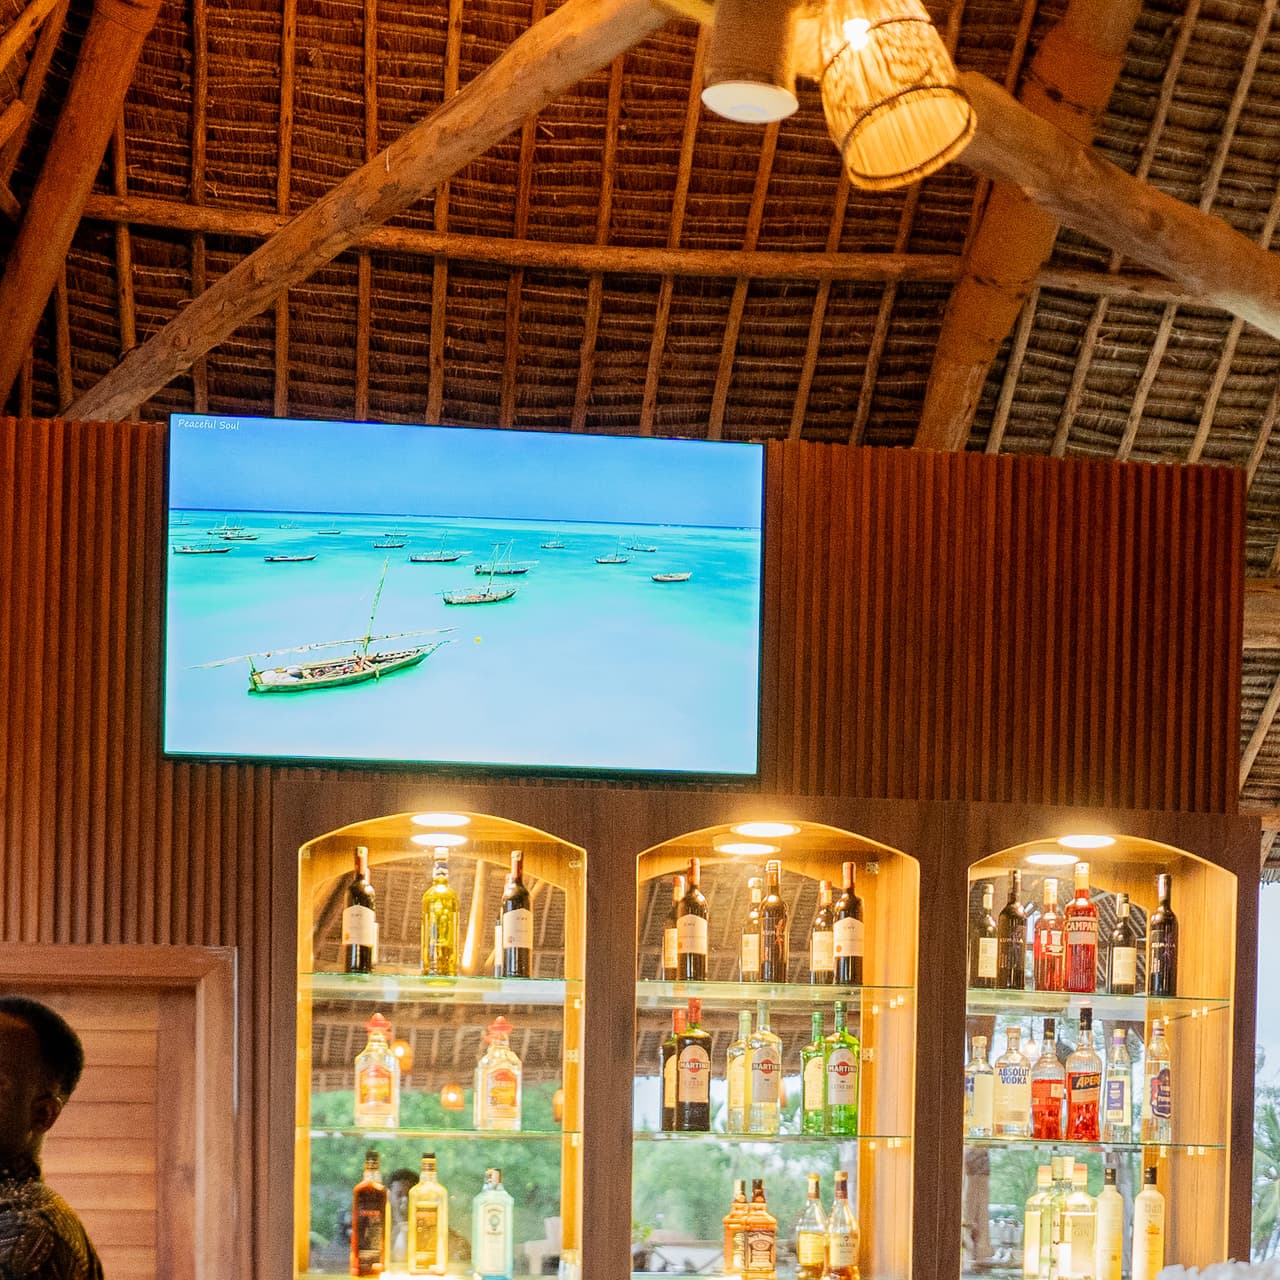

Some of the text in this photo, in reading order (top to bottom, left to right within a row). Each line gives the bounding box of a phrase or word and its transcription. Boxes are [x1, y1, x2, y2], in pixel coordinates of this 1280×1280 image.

[177, 418, 240, 431] Peaceful Soul
[998, 1068, 1030, 1077] ABSOLUT
[1001, 1076, 1027, 1085] VODKA
